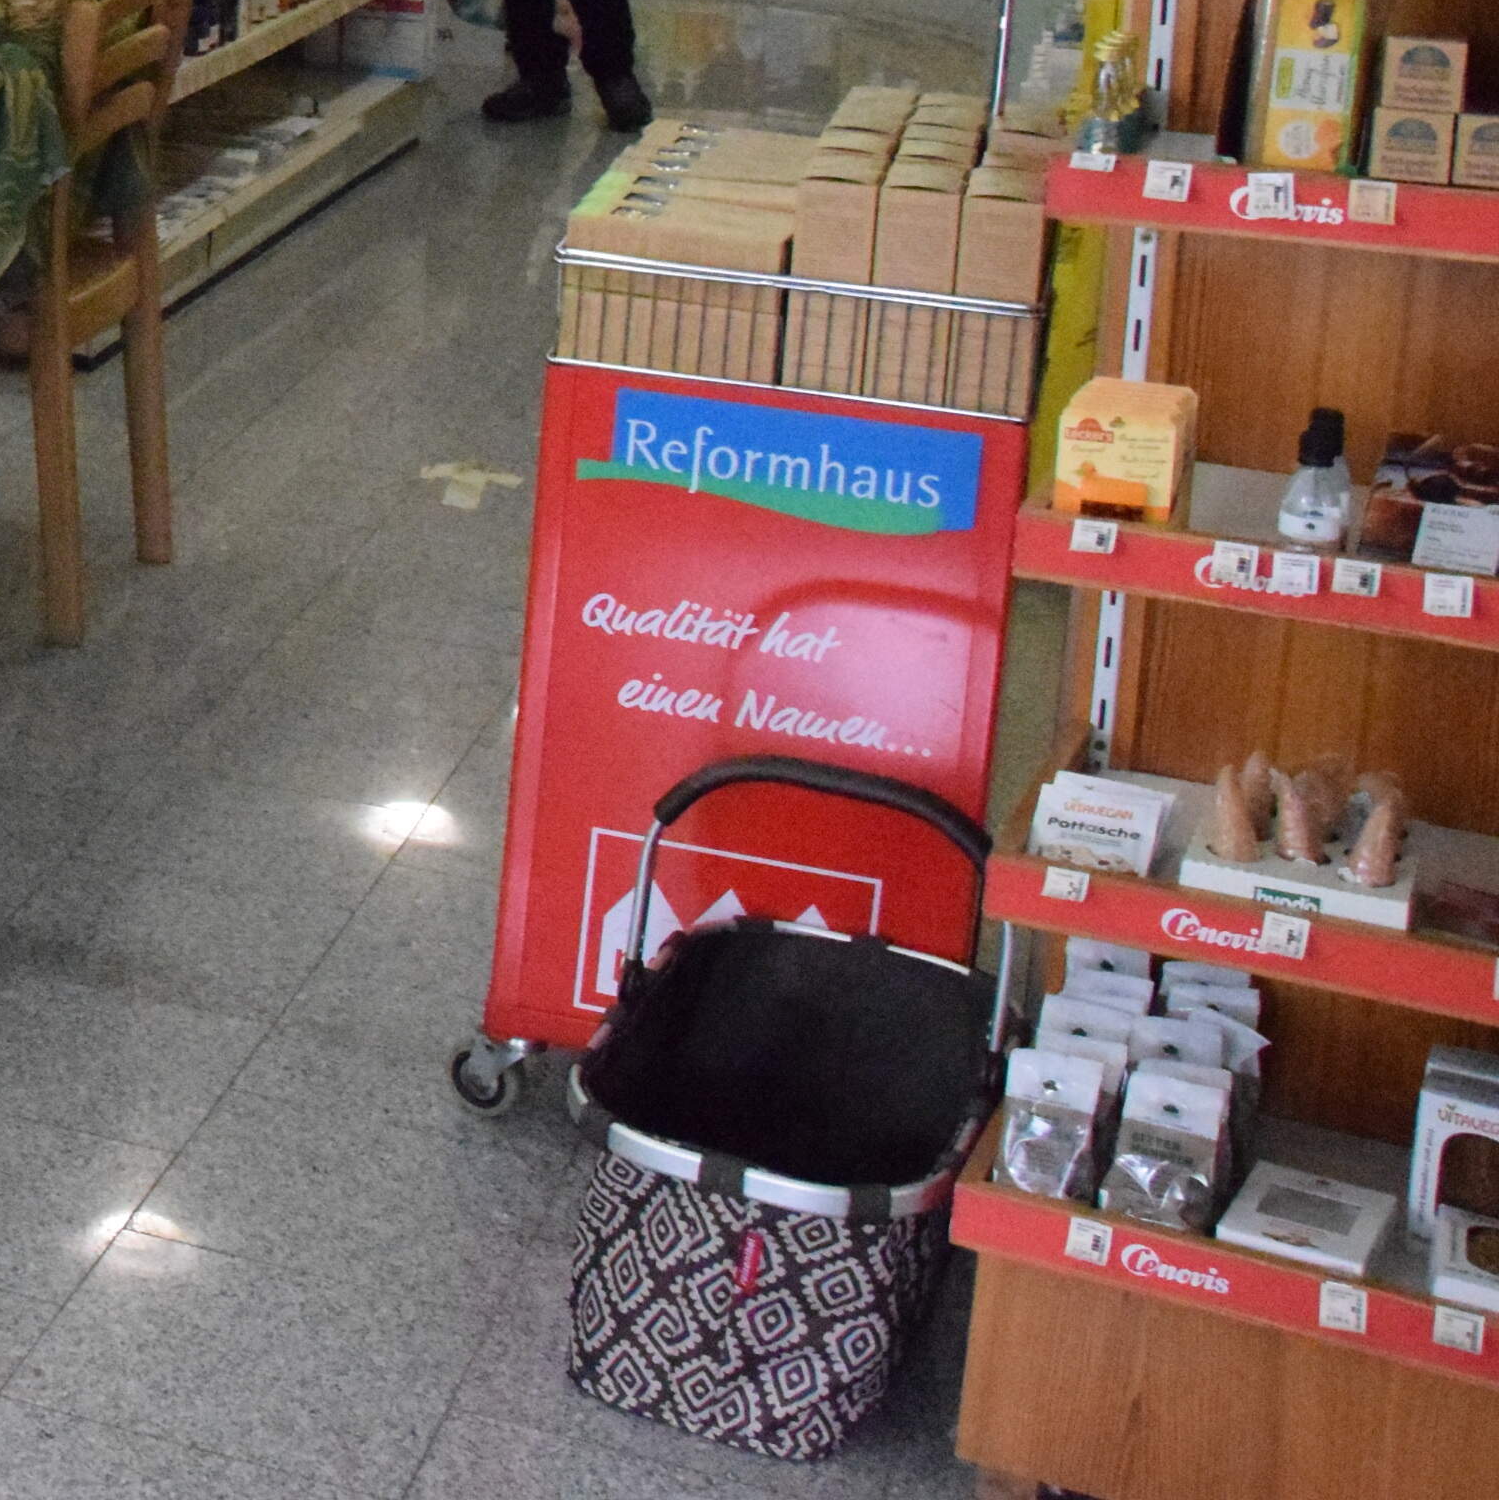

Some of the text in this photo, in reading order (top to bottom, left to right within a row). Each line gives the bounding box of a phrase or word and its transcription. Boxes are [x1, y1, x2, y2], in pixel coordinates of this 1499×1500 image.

[625, 416, 942, 510] Reformhaus
[581, 591, 841, 664] Qualität hat
[616, 673, 933, 759] einen Namen...
[1046, 816, 1142, 841] Pottasche
[1120, 1243, 1231, 1294] Cenovis
